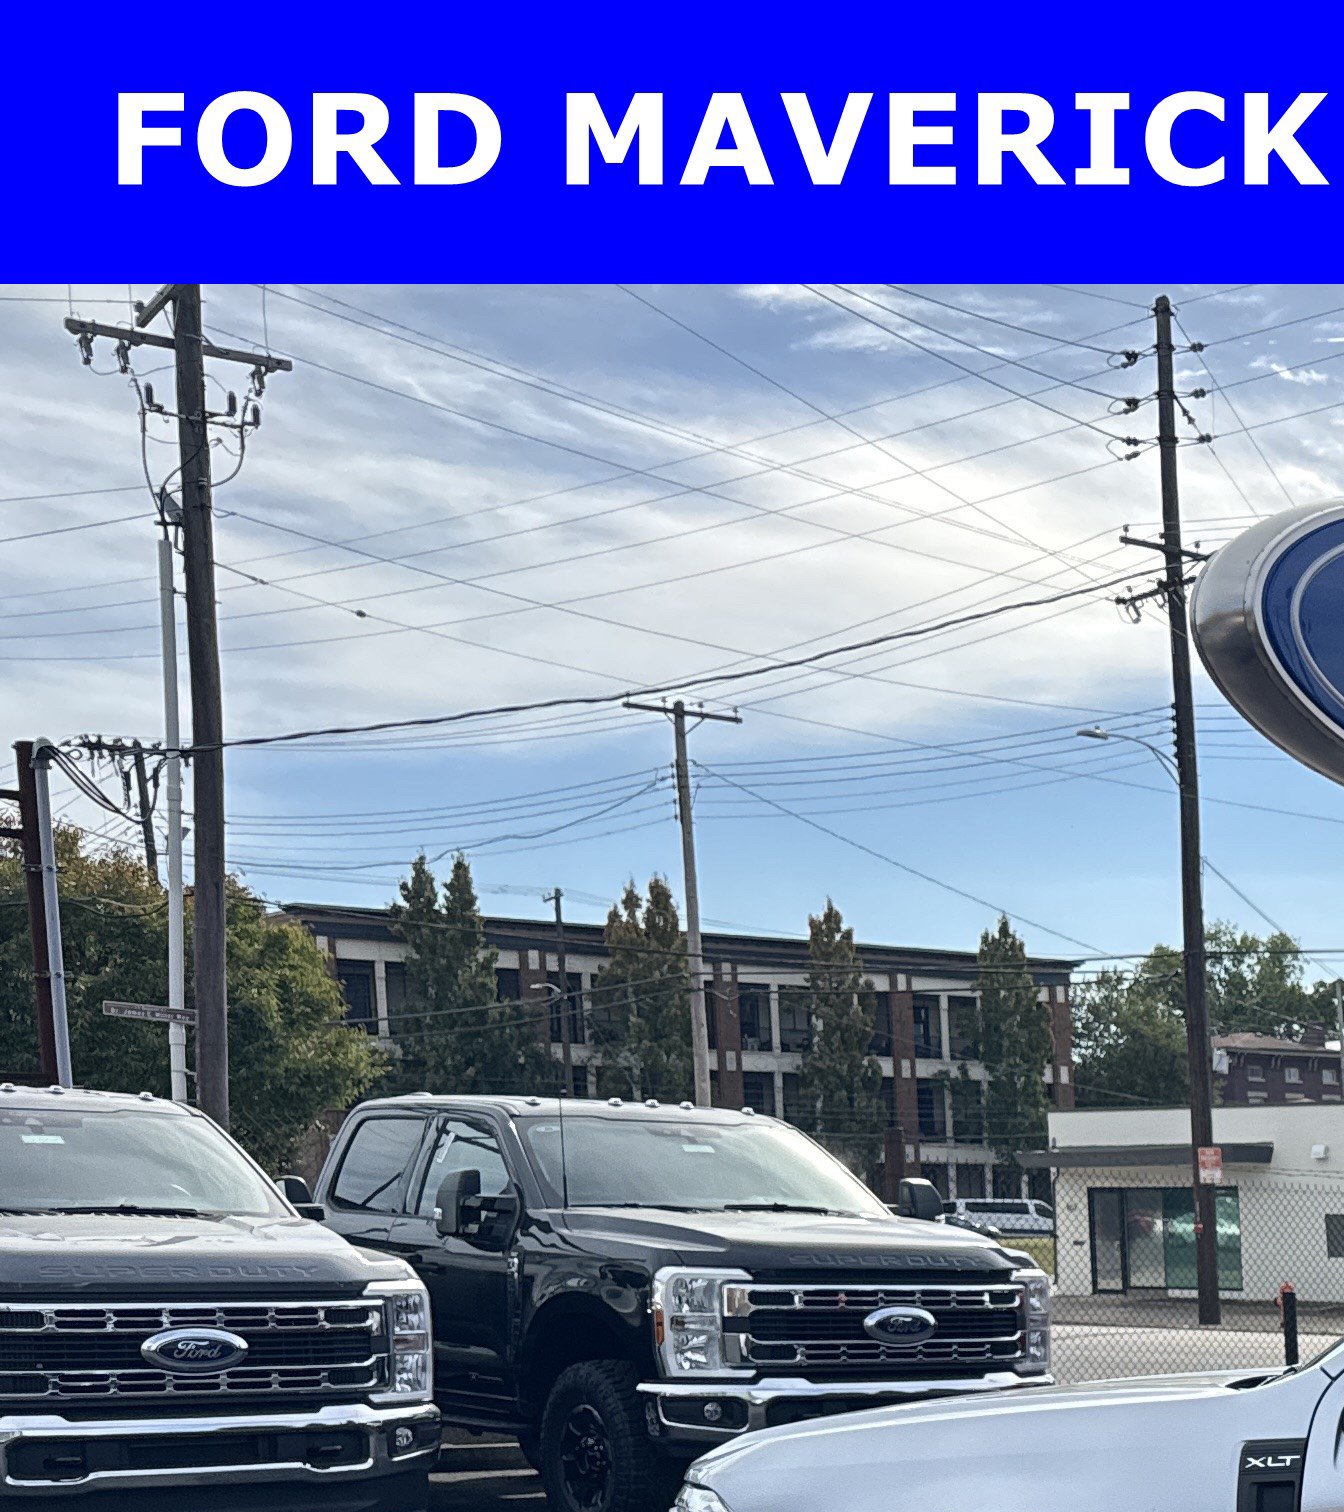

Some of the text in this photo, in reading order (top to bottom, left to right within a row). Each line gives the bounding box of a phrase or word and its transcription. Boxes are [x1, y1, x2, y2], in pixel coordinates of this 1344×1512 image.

[789, 1253, 979, 1267] SUPER DUTY
[39, 1263, 319, 1279] SUPER DUTY
[173, 1340, 222, 1359] Ford
[1244, 1454, 1301, 1469] XLT
